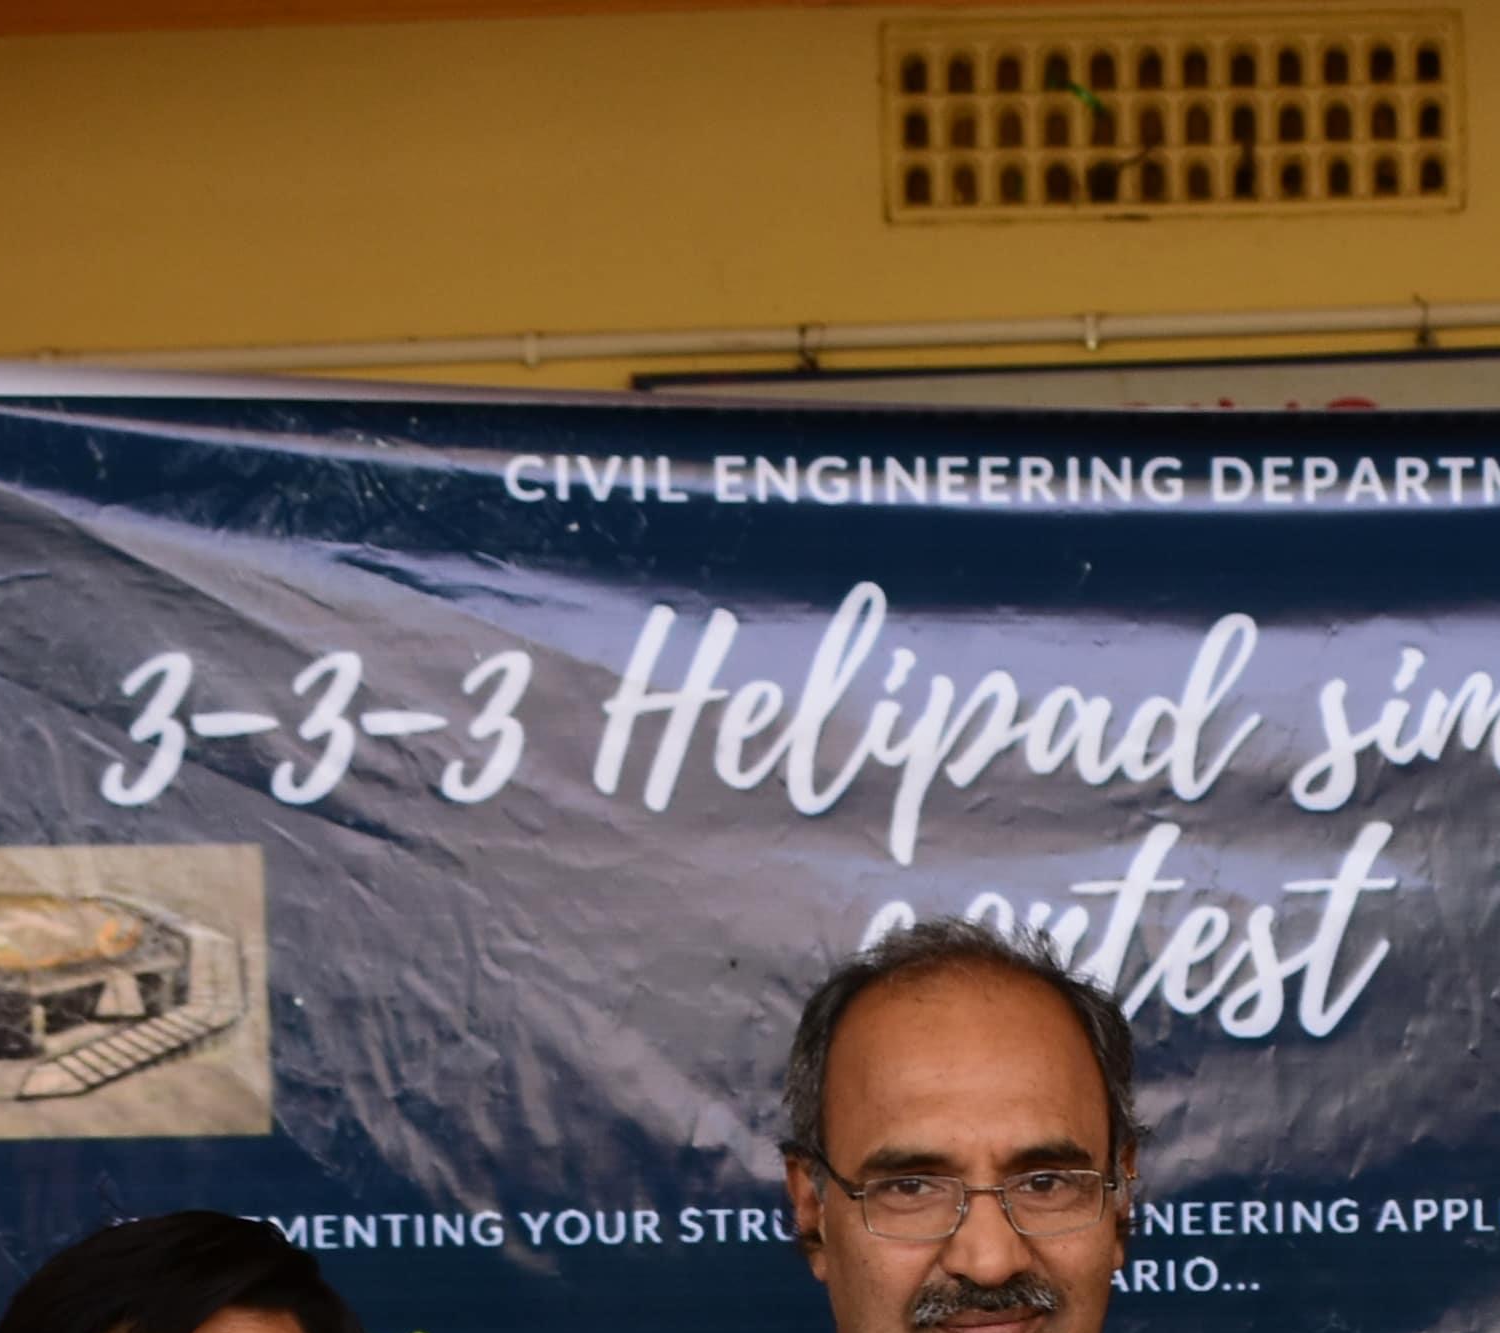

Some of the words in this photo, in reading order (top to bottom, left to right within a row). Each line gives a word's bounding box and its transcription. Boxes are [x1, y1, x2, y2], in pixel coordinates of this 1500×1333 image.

[504, 455, 688, 501] CIVIL
[714, 456, 1184, 503] ENGINEERING
[101, 650, 532, 806] 3-3-3
[593, 580, 1261, 867] Helipad
[237, 1210, 504, 1249] MENTING
[520, 1208, 662, 1246] YOUR
